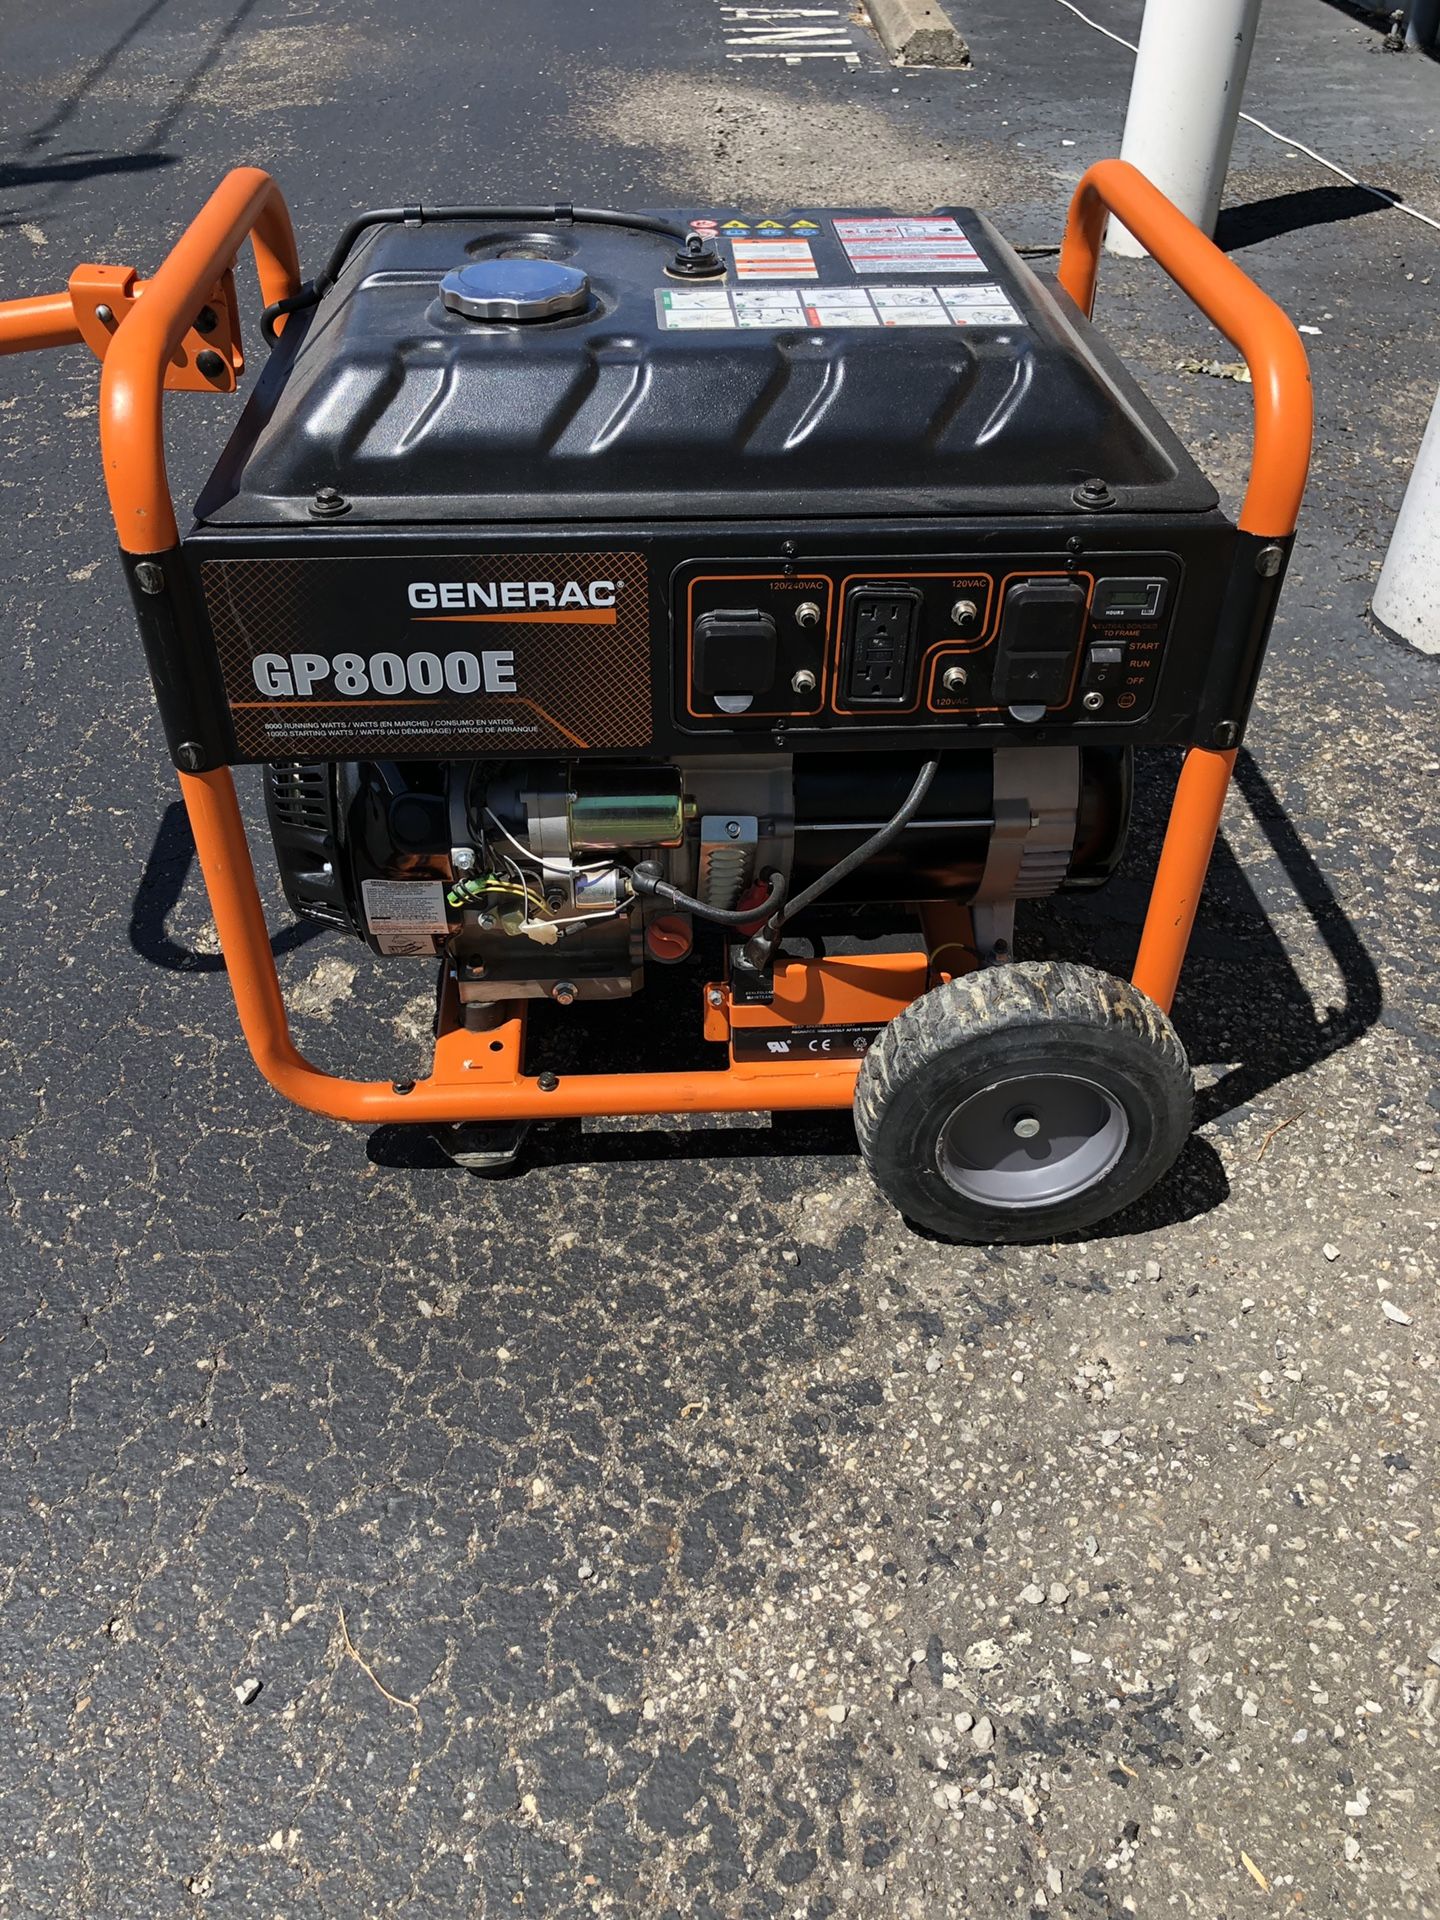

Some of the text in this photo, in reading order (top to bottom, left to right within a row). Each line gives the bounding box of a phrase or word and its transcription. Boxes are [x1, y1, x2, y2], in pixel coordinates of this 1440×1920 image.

[769, 581, 824, 590] 120/240VAC
[952, 579, 987, 588] 120VAC
[1129, 642, 1160, 650] START
[1129, 660, 1151, 668] RUN
[251, 650, 518, 697] GP8000E
[1126, 677, 1145, 685] OFF
[935, 697, 969, 706] 120VAC
[401, 727, 452, 735] DÉMARRAGE)
